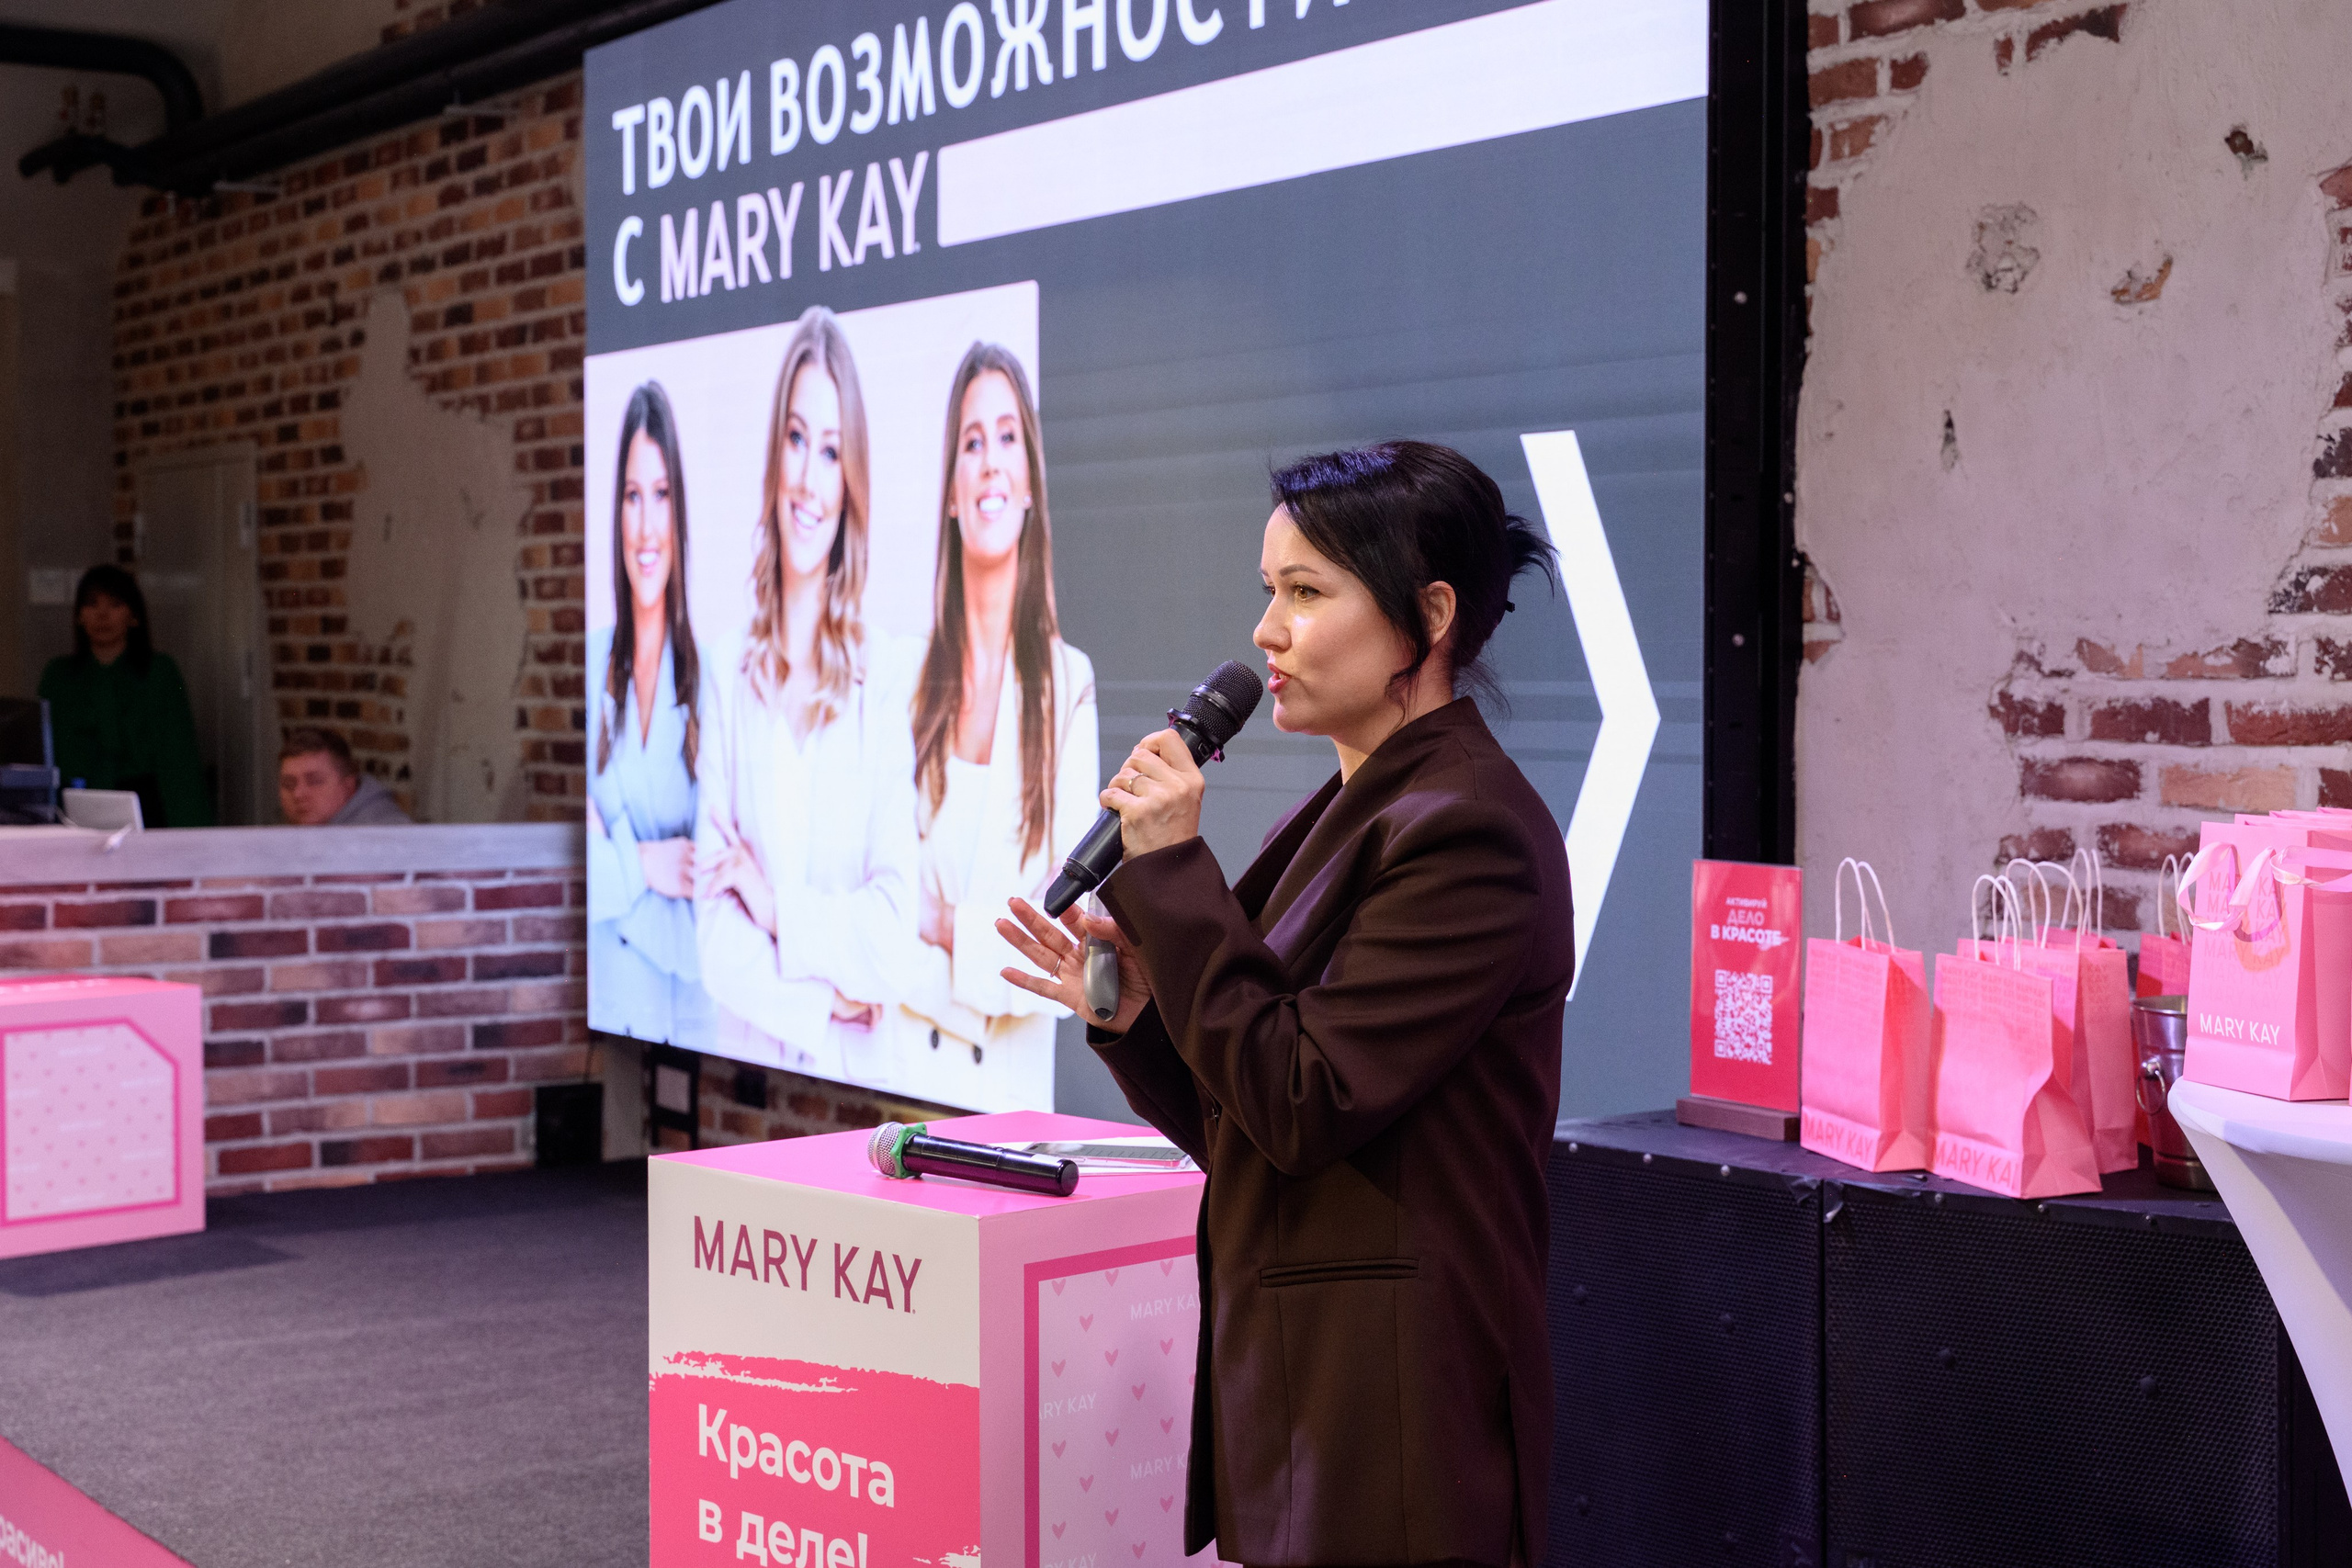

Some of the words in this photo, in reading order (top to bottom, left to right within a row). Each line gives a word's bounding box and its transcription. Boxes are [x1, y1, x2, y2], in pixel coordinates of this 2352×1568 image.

[612, 69, 752, 195] ТВОИ
[770, 0, 1350, 156] ВОЗМОЖНО
[613, 215, 645, 307] С
[660, 182, 804, 303] MARY
[1711, 924, 1720, 939] В
[1722, 925, 1781, 946] КРАСОТЕ
[1727, 908, 1765, 926] ДЕЛО
[2199, 1012, 2245, 1039] MARY
[2249, 1021, 2280, 1045] KAY
[1804, 1113, 1843, 1146] MARY
[1847, 1132, 1872, 1164] KAY
[1936, 1140, 1984, 1177] MARY
[694, 1215, 818, 1292] MARY
[834, 1242, 922, 1314] KAY
[1131, 1297, 1172, 1322] MARY
[1068, 1392, 1096, 1415] KAY
[698, 1403, 895, 1507] Красота
[1131, 1455, 1172, 1480] MARY
[698, 1498, 723, 1543] в
[736, 1510, 868, 1568] деле!
